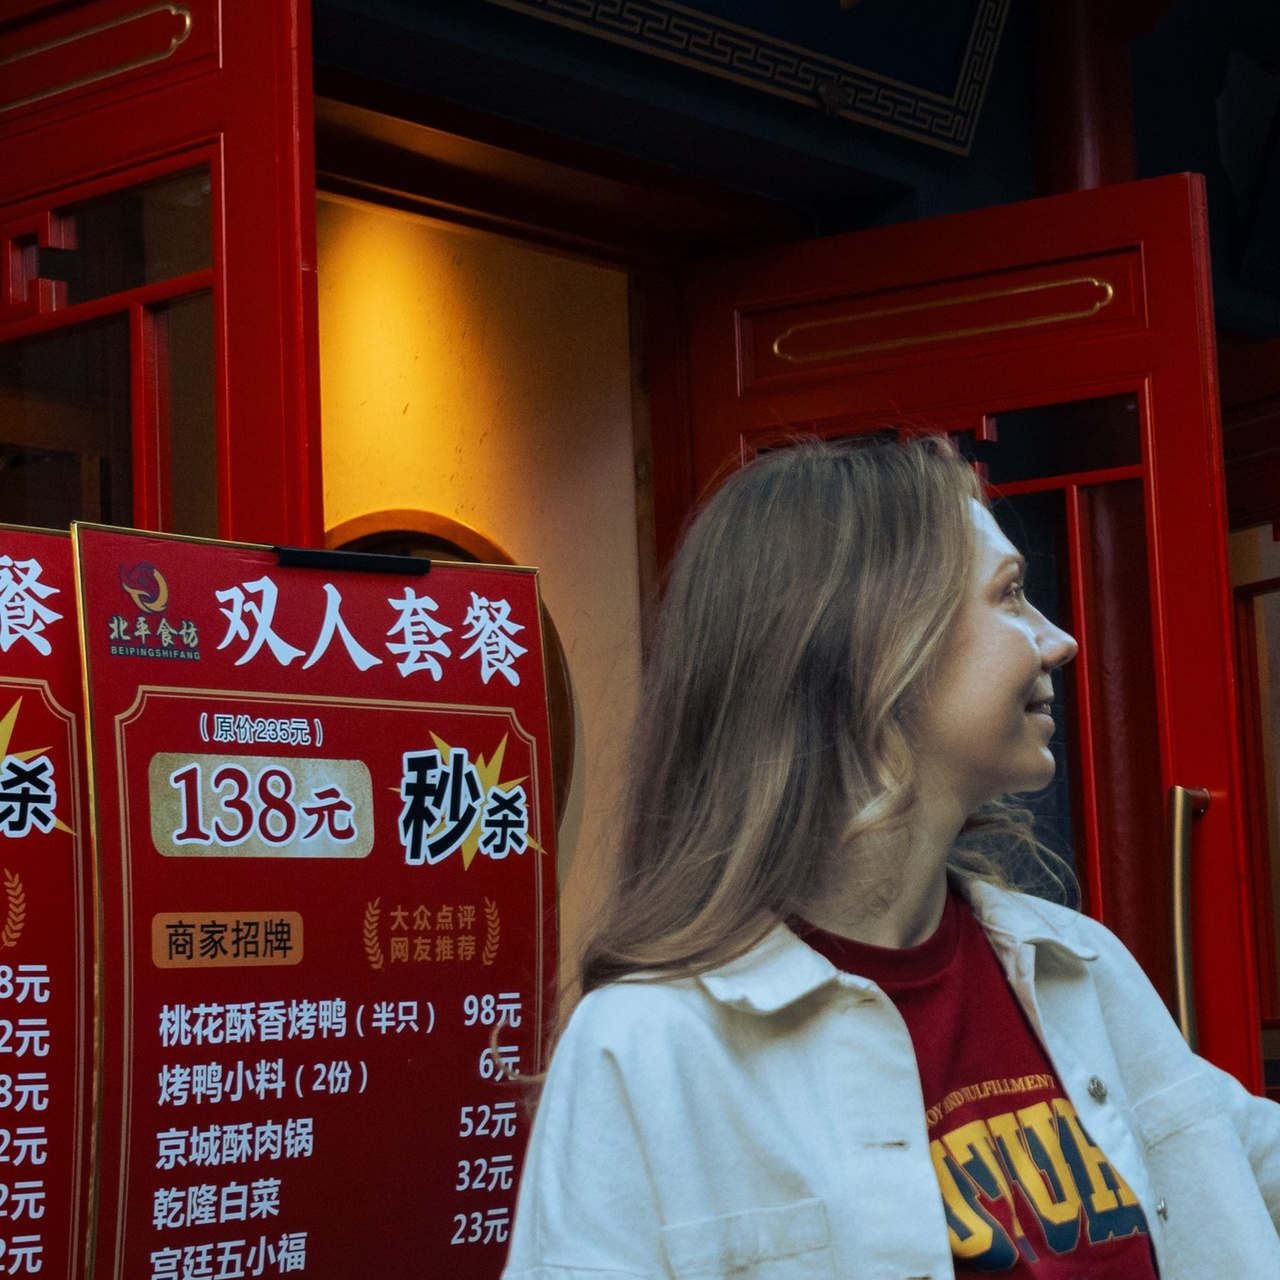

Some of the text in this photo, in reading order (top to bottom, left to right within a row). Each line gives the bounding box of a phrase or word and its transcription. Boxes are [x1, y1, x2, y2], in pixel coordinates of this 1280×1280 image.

[108, 615, 200, 648] 北平食坊
[215, 575, 530, 687] 双人套餐
[110, 645, 201, 661] BEIPINGSHIFANG
[171, 761, 357, 848] 138元
[401, 747, 530, 865] 秒杀
[390, 904, 477, 931] 大众点评
[166, 919, 294, 961] 商家招牌
[390, 935, 477, 963] 网友推荐
[463, 992, 523, 1029] 98元
[479, 1045, 522, 1082] 6元
[155, 1101, 517, 1170] 京城酥肉锅 52元
[152, 1154, 514, 1231] 乾隆白菜 32元
[450, 1207, 510, 1246] 23元
